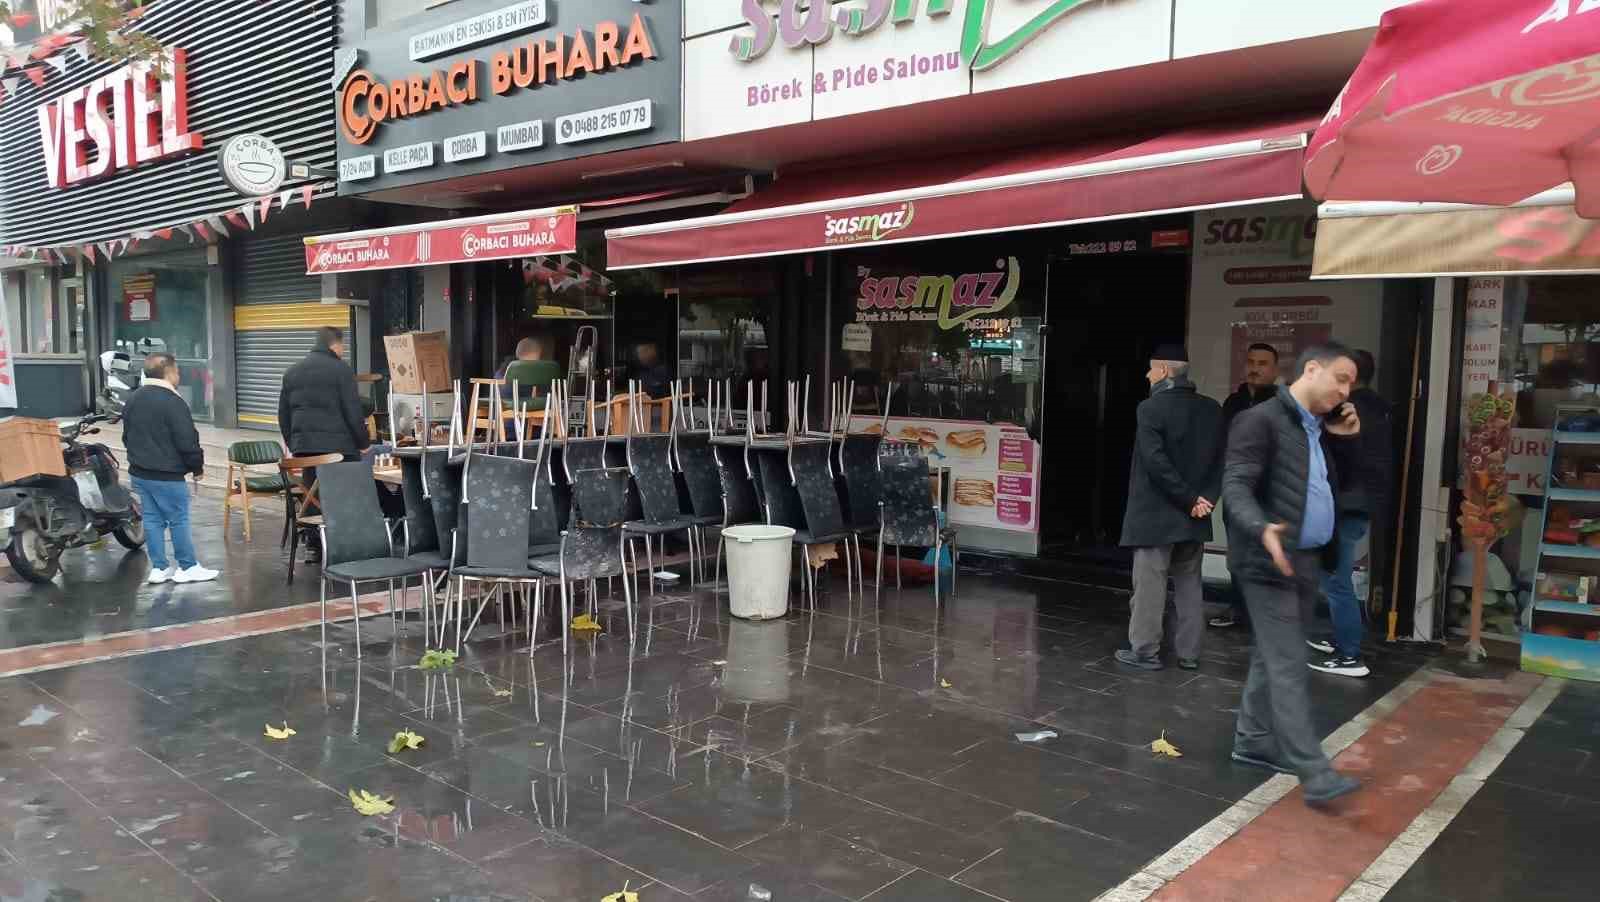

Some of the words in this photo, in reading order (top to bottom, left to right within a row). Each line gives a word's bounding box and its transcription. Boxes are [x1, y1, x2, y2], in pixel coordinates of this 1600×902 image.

[505, 10, 517, 27] EN
[492, 12, 654, 96] BUHARA
[747, 78, 802, 107] Börek
[813, 72, 827, 94] &
[832, 63, 877, 92] Pide
[883, 50, 960, 81] Salonu
[38, 47, 203, 189] VESTEL
[575, 116, 598, 134] 0488
[601, 113, 617, 129] 215
[620, 109, 632, 126] 07
[634, 106, 646, 123] 79
[500, 125, 539, 147] MUMBAR
[512, 231, 556, 247] BUHARA
